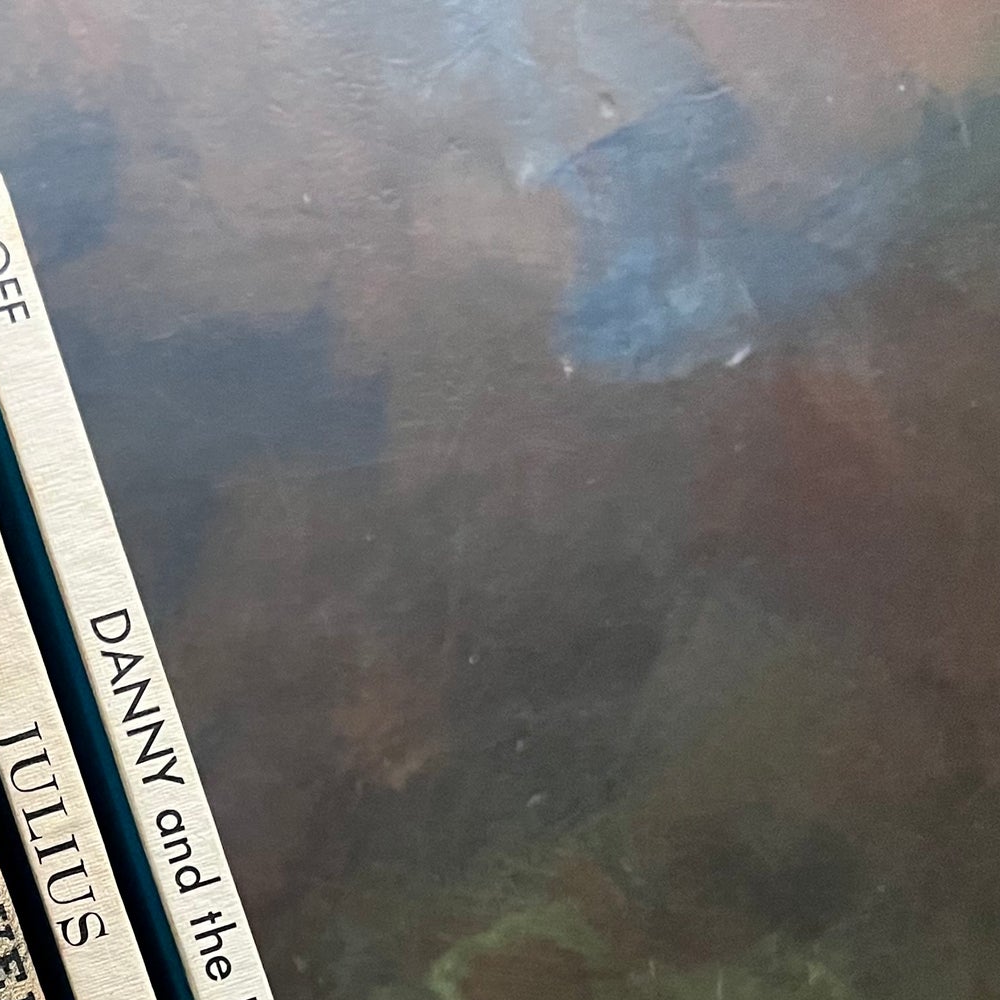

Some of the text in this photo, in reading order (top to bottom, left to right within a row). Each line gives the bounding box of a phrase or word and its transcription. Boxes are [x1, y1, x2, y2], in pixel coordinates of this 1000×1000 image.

[90, 608, 185, 786] DANNY
[156, 808, 221, 895] and
[190, 909, 238, 983] the
